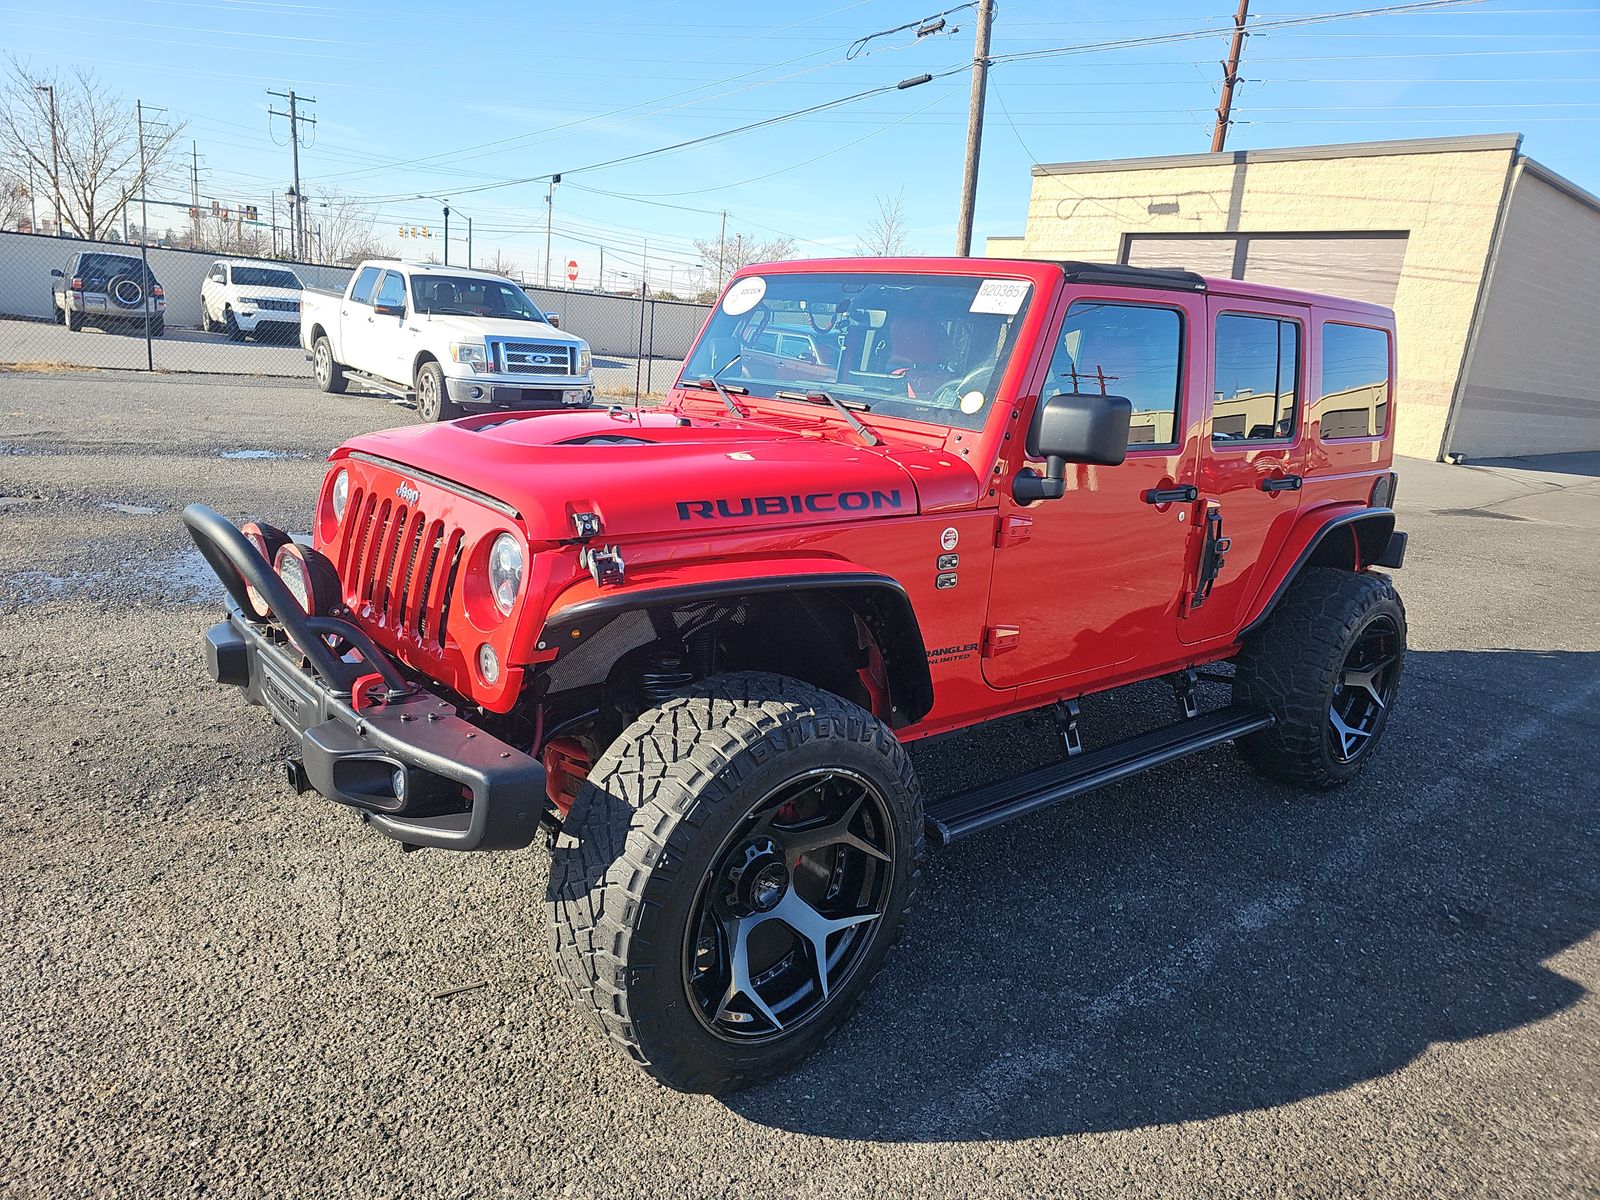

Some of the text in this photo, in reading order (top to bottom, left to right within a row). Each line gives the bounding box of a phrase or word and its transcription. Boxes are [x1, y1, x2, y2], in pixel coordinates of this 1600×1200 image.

[980, 284, 1029, 298] 8203857
[395, 480, 419, 507] Jeep
[675, 489, 902, 521] RUBICON
[926, 643, 978, 657] RANGLER
[928, 653, 970, 665] NLIMITED
